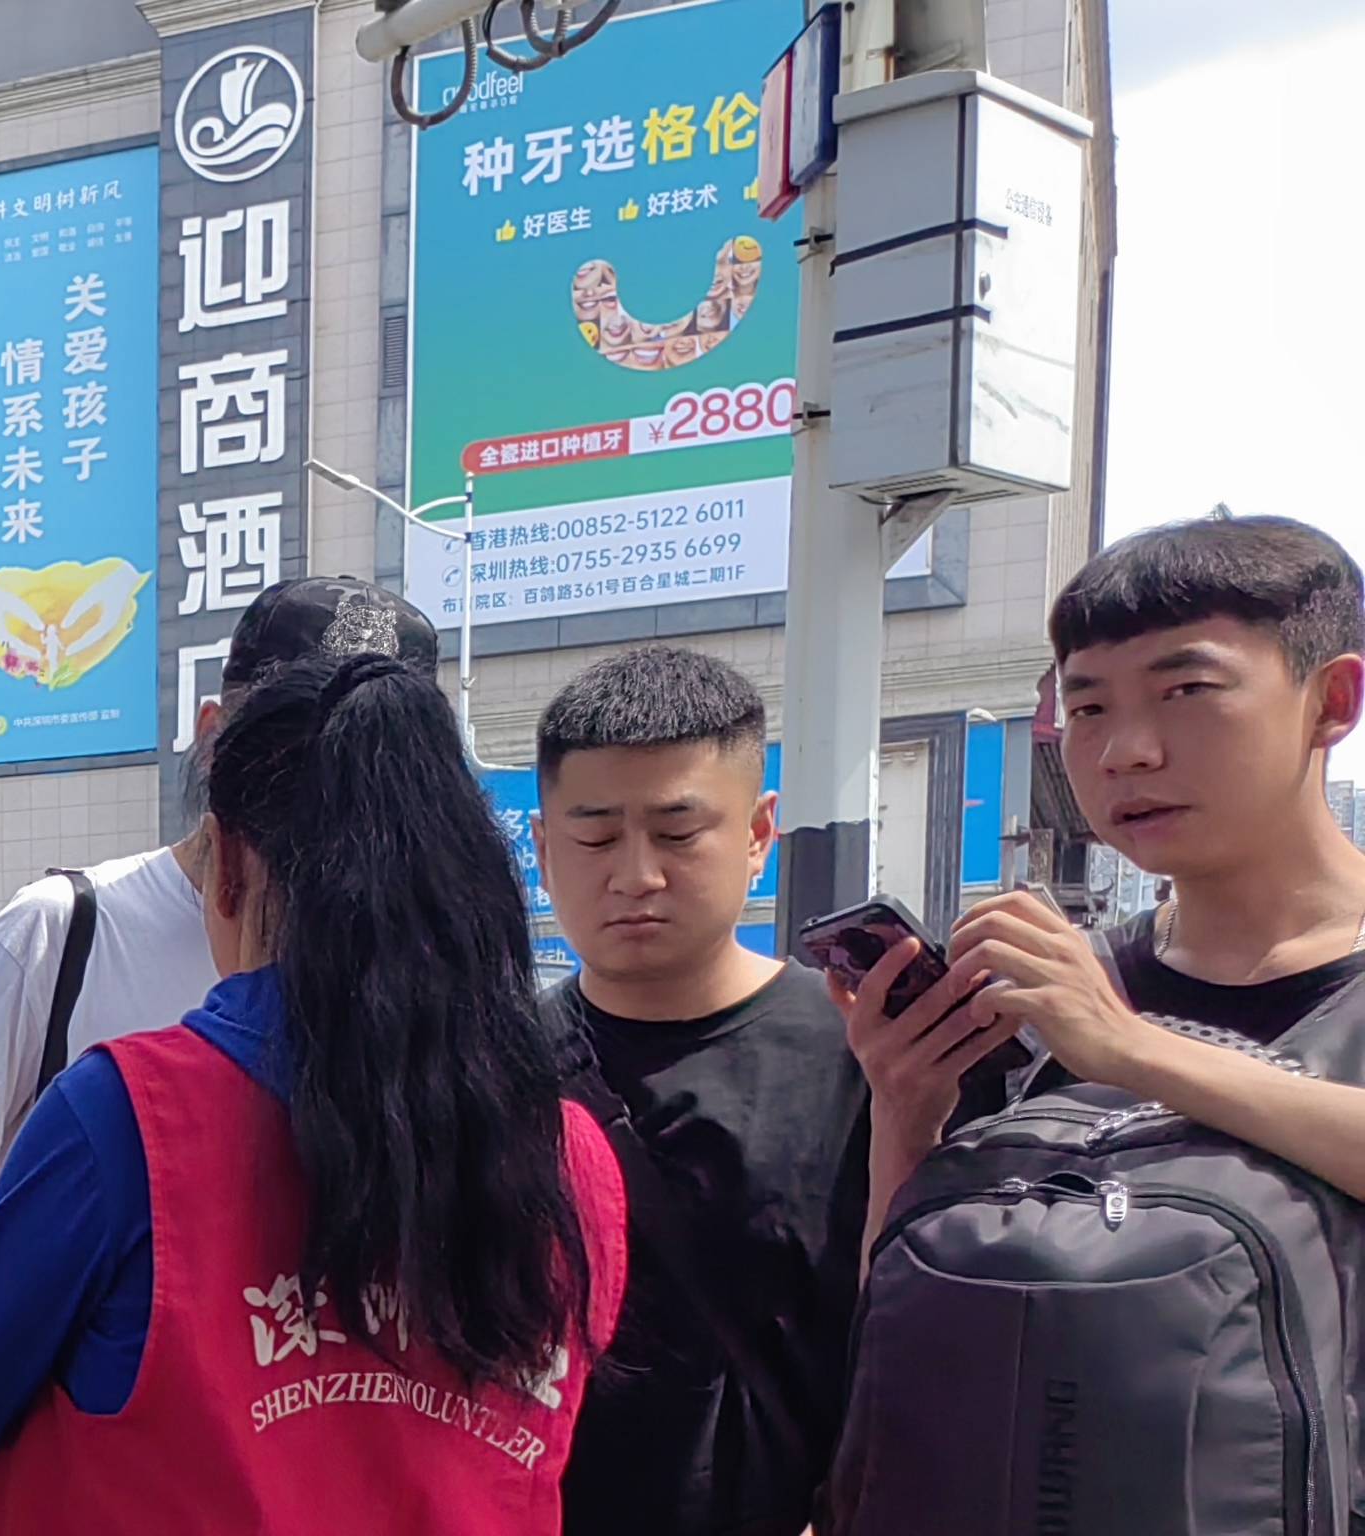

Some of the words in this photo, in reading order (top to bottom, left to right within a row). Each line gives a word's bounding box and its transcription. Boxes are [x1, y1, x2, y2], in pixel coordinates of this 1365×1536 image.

[462, 91, 760, 196] 种牙选格伦
[522, 206, 593, 239] 好医生
[646, 183, 718, 218] 好技术
[62, 272, 109, 482] 关爱孩子
[0, 337, 45, 545] 情系未来
[478, 427, 623, 468] 全瓷进口种植牙
[696, 498, 746, 523] 6011
[684, 532, 742, 558] 6699
